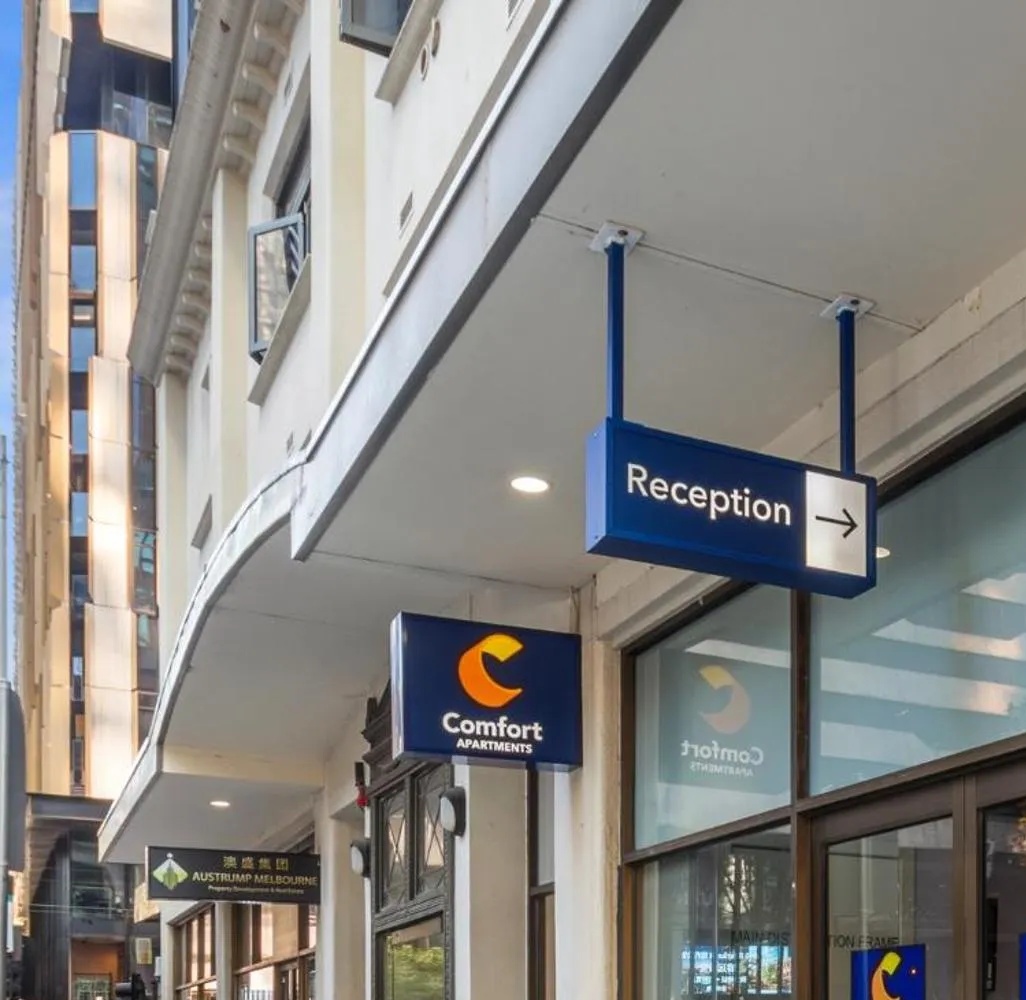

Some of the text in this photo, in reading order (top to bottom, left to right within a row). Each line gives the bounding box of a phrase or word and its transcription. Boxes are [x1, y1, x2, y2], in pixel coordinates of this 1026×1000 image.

[628, 463, 791, 526] Reception
[442, 712, 543, 740] Comfort
[456, 739, 533, 754] APARTMENTS
[192, 872, 318, 886] AUSTRUMP MELBOURNE
